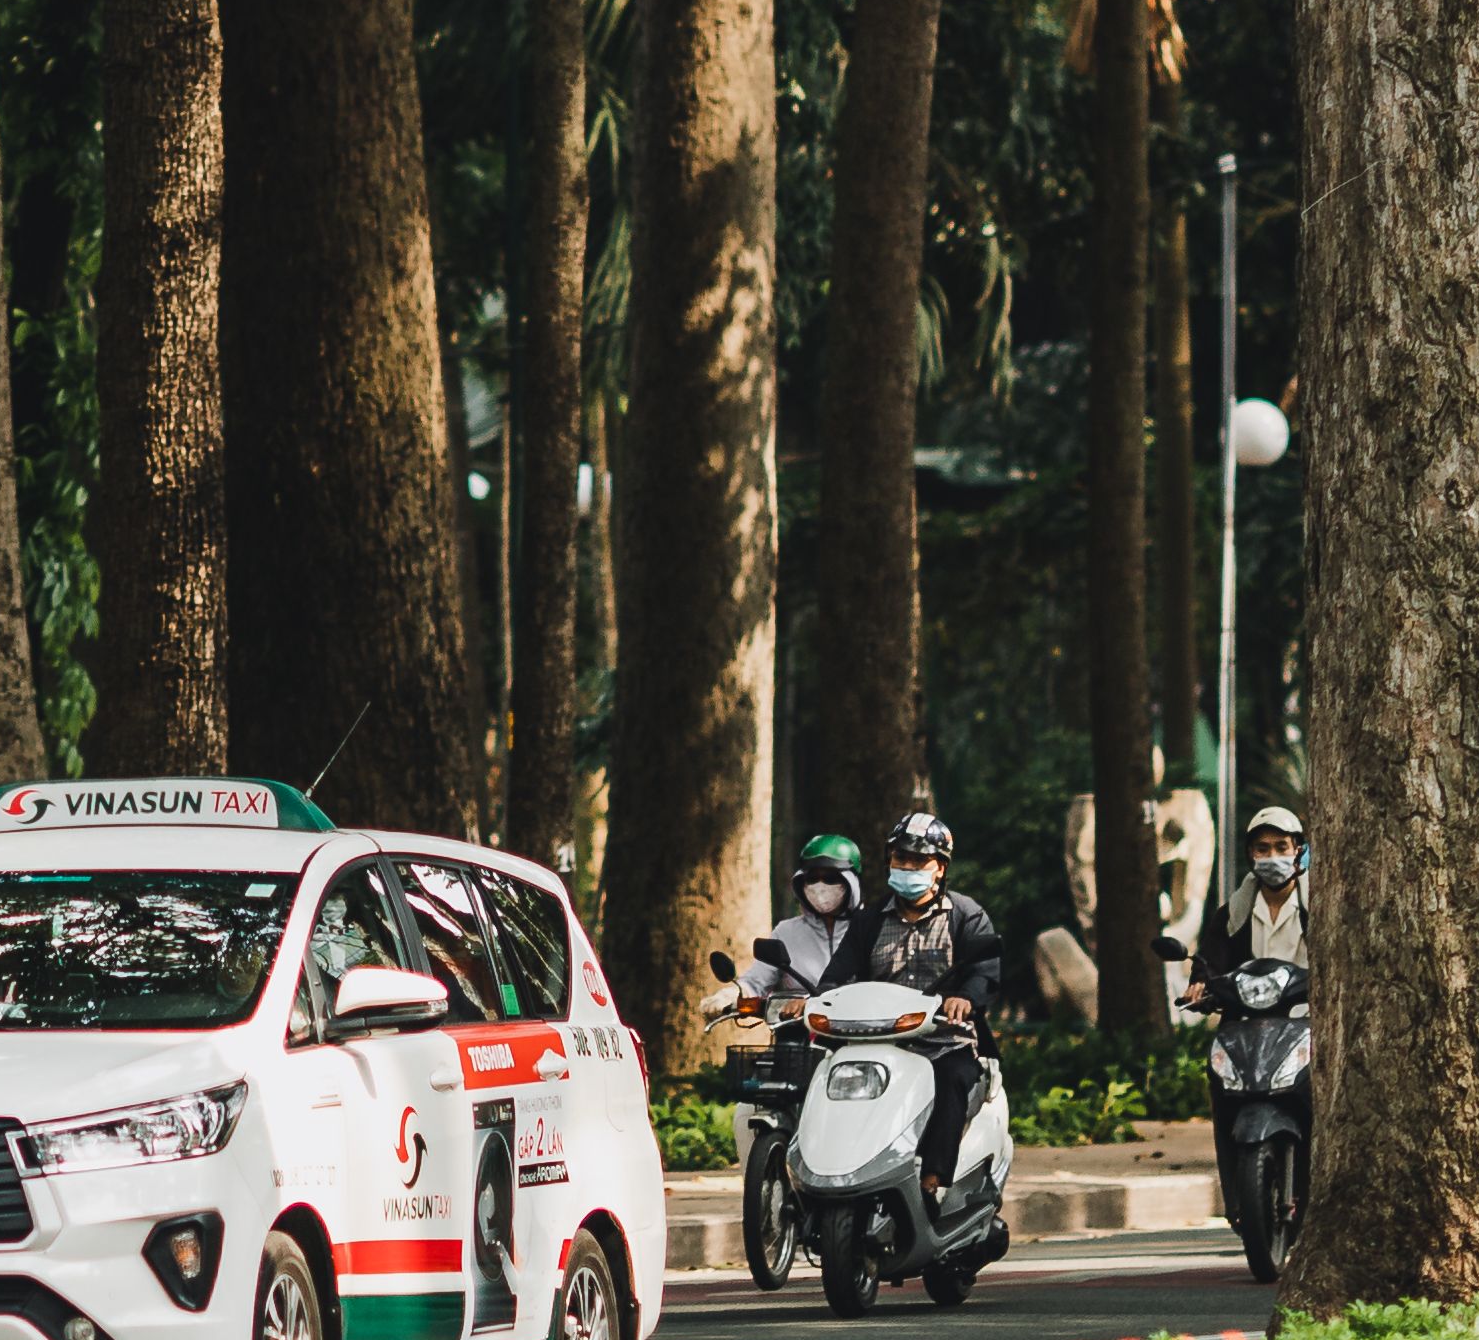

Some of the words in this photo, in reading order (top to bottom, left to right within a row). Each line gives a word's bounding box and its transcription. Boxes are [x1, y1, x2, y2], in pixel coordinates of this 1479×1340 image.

[65, 790, 203, 816] VINASUN
[211, 791, 269, 814] TAXI
[467, 1043, 515, 1072] TOSHIBA
[536, 1117, 544, 1156] 2
